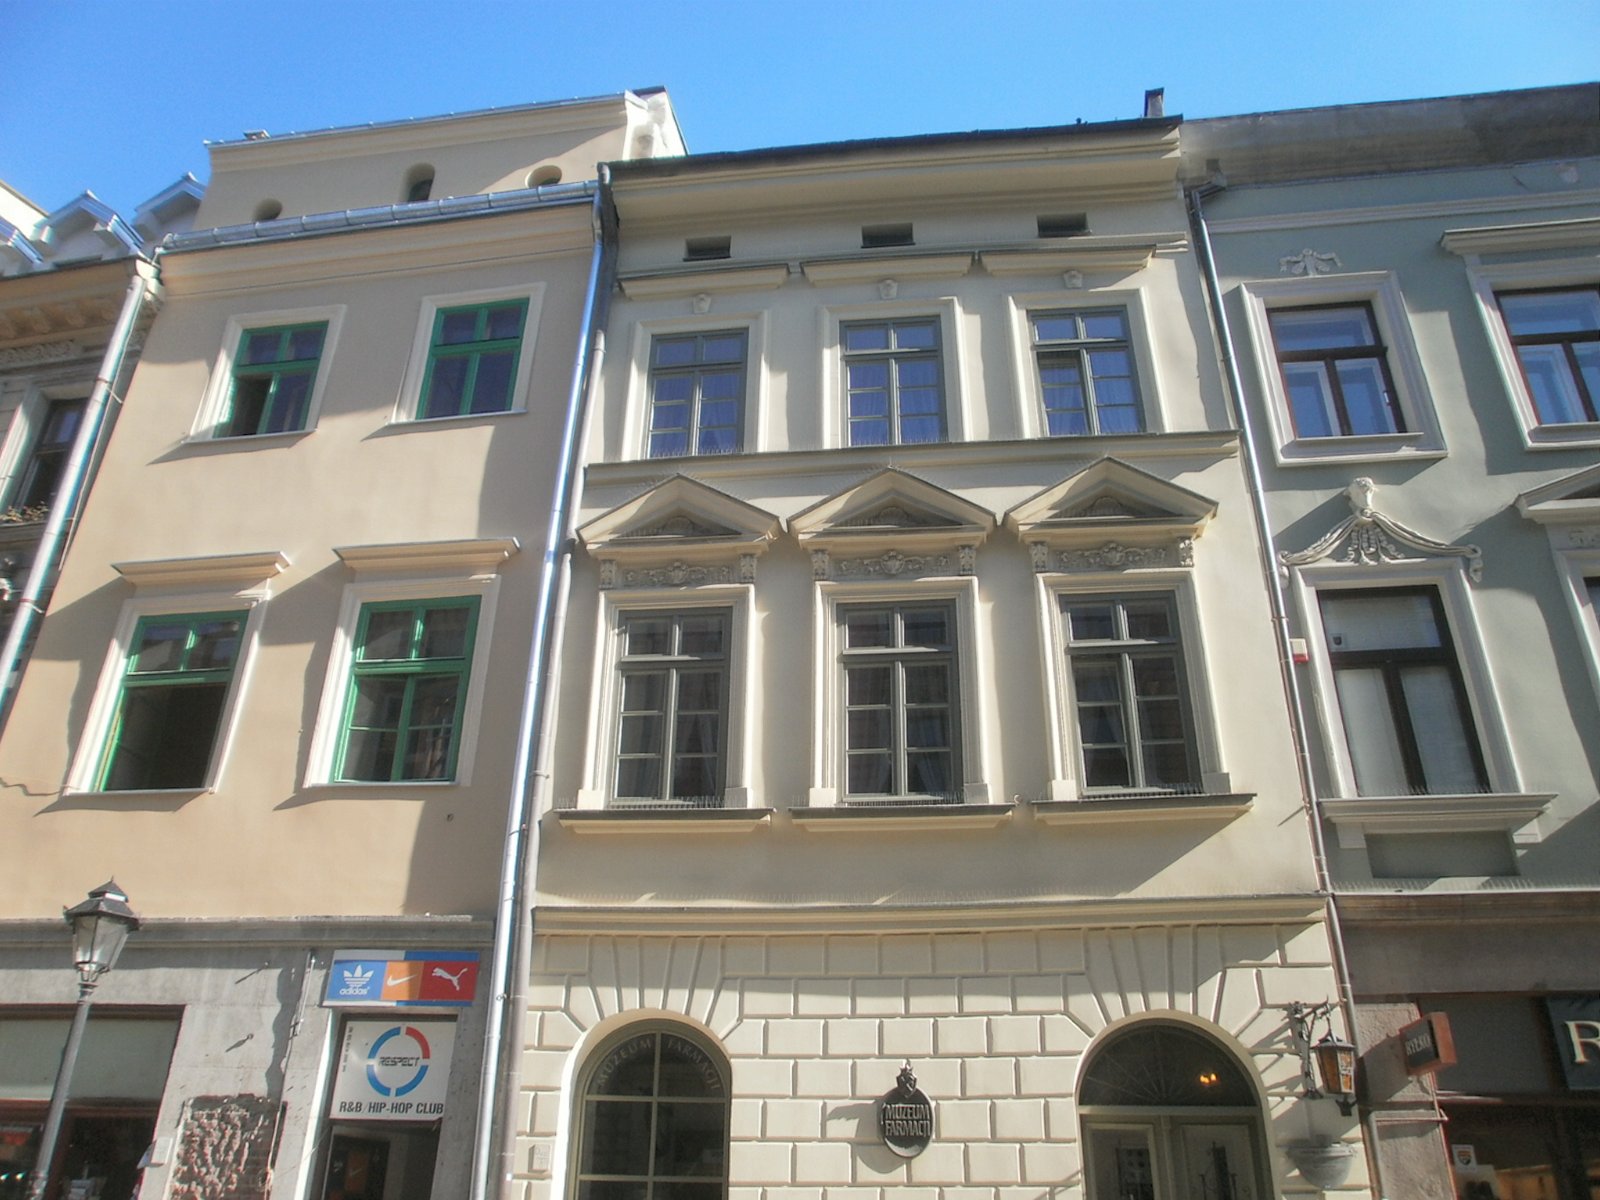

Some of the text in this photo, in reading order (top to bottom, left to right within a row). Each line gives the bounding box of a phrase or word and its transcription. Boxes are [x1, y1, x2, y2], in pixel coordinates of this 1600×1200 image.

[339, 984, 368, 995] adidas
[378, 1056, 419, 1067] RESPECT
[597, 1038, 721, 1089] MUZEUM FARMACJI
[339, 1101, 363, 1112] R&B
[368, 1102, 413, 1113] HIP-HOP
[416, 1103, 444, 1114] CLUB
[885, 1104, 930, 1119] MUZEUM
[885, 1120, 931, 1136] FARMACJI
